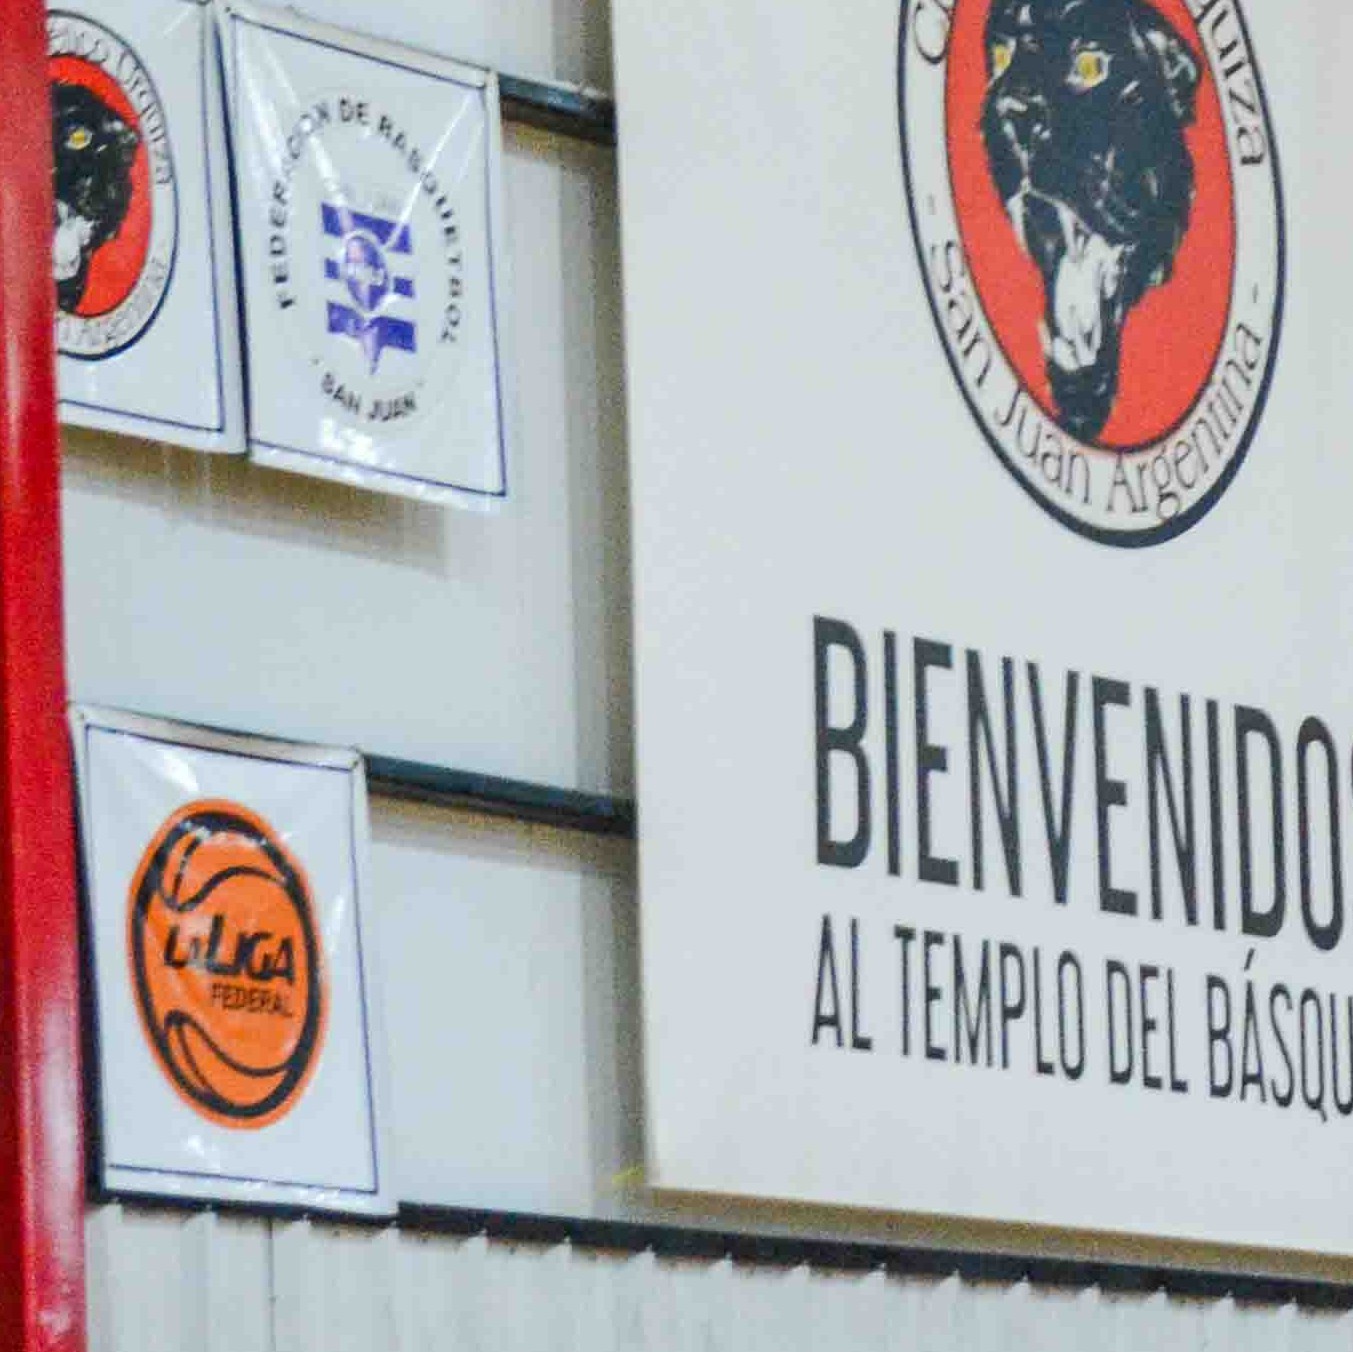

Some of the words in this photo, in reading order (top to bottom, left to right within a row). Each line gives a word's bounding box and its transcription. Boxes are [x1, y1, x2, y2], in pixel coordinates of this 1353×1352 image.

[930, 240, 992, 390] San
[993, 388, 1090, 506] Juan
[1105, 322, 1265, 521] Argentina
[811, 913, 873, 1051] AL
[894, 922, 1086, 1081] TEMPLO
[1106, 958, 1188, 1093] DEL
